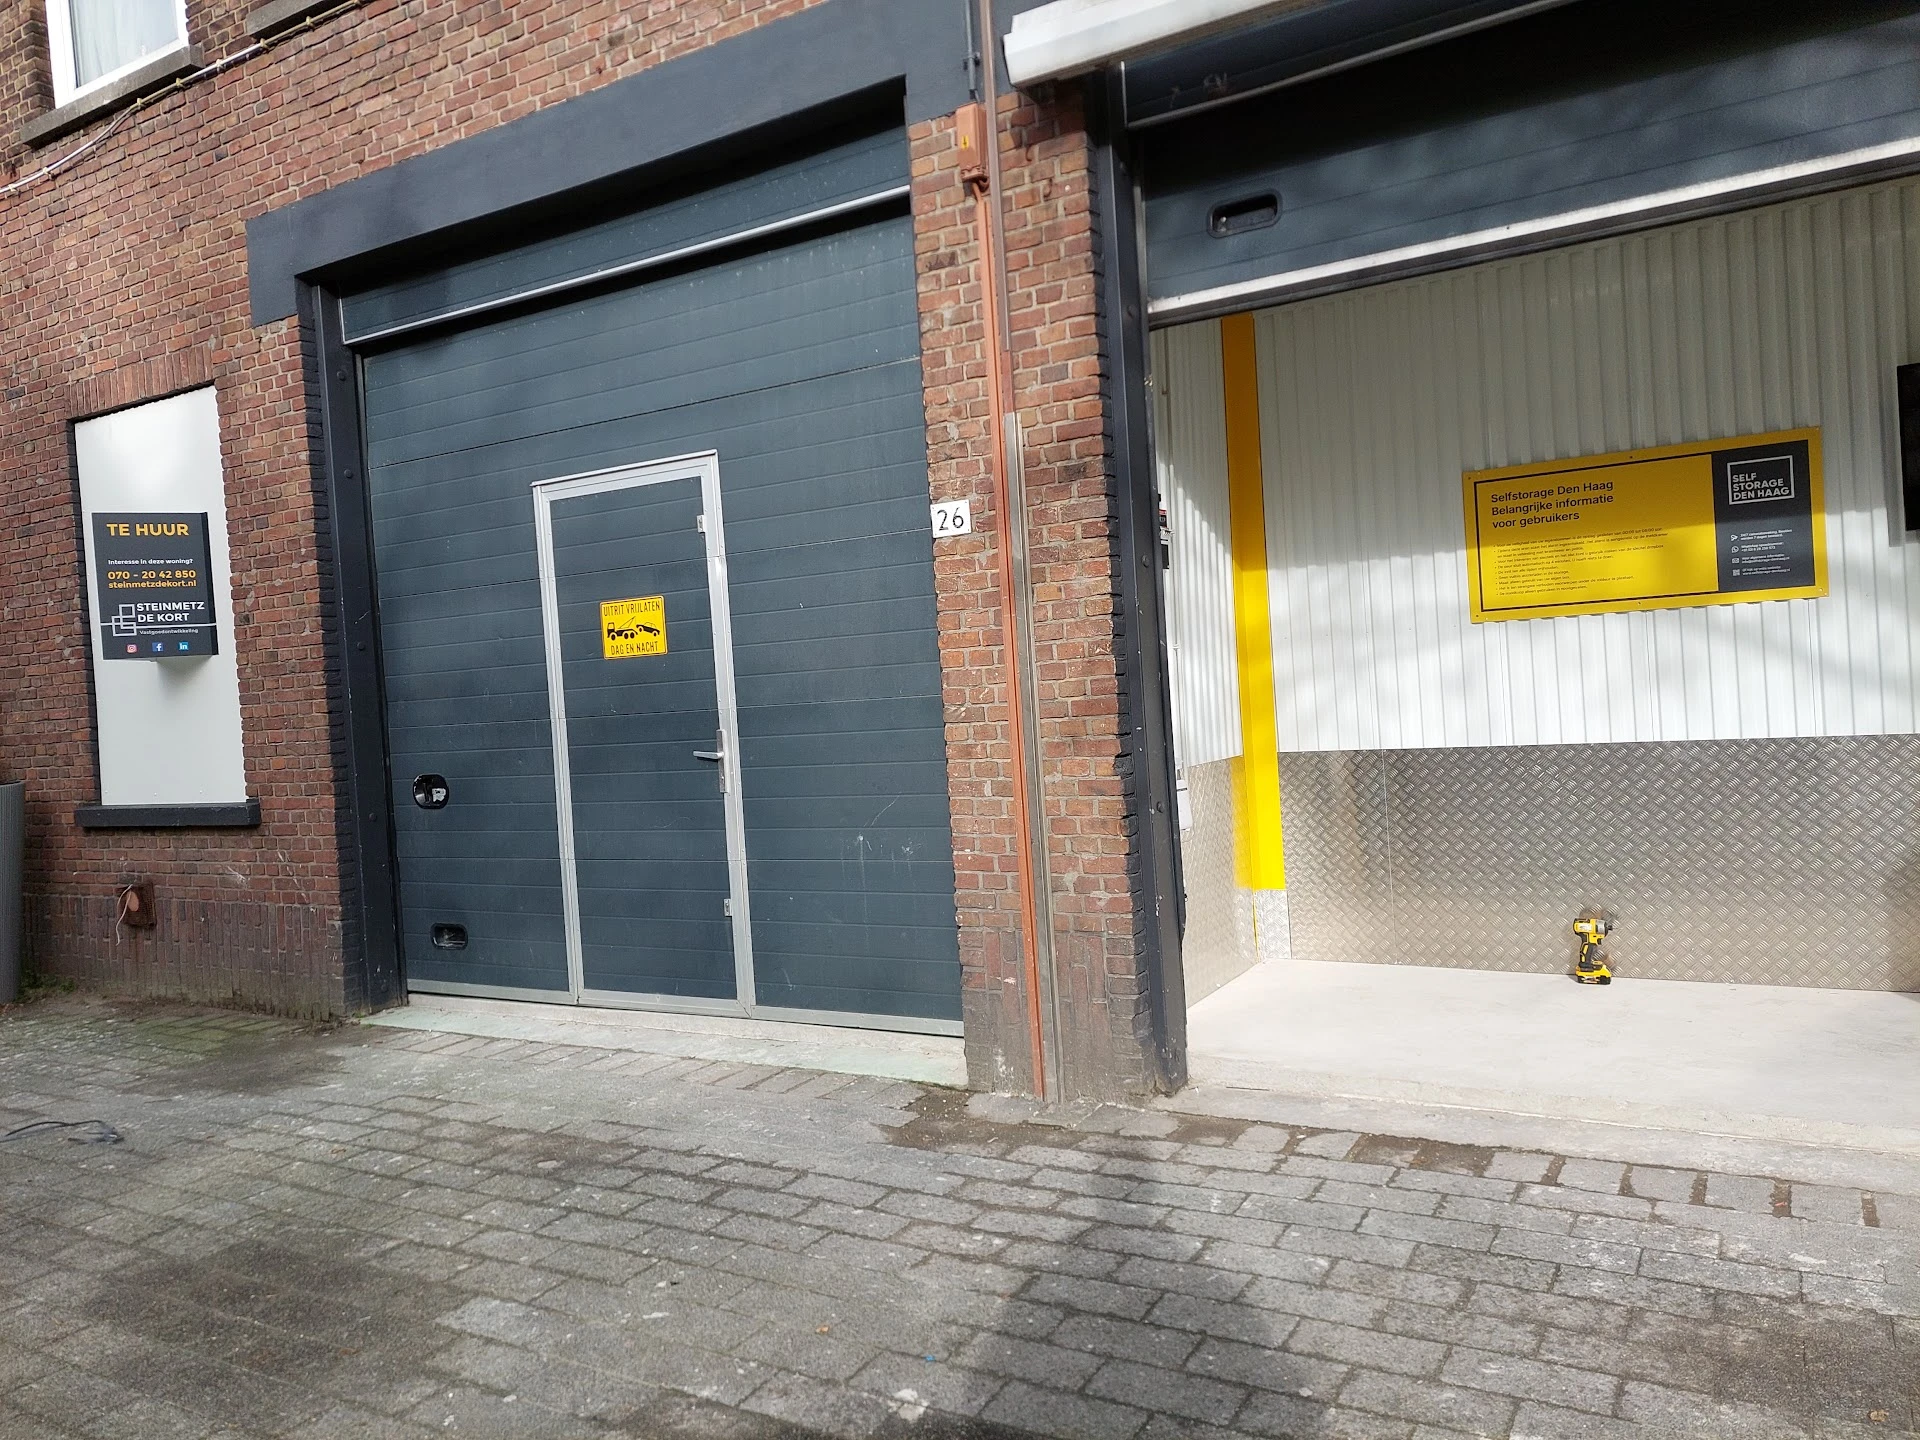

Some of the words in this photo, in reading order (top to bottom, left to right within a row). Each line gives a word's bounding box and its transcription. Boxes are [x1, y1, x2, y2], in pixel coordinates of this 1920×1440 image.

[1732, 472, 1757, 483] SELF
[1491, 488, 1554, 503] Selfstorage
[1557, 485, 1580, 495] Den
[1583, 481, 1614, 492] Haag
[1733, 478, 1784, 492] STORAGE
[1733, 491, 1755, 500] DEN
[1757, 487, 1790, 497] HAAG
[1492, 501, 1553, 516] Belangrijke
[1555, 494, 1614, 509] informatie
[937, 507, 964, 531] 26
[1492, 519, 1517, 529] voor
[1519, 512, 1580, 528] gebruikers
[106, 523, 131, 537] TE
[135, 523, 190, 536] HUUR
[165, 558, 194, 566] woning?
[107, 571, 131, 580] 070
[141, 570, 156, 579] 20
[158, 570, 173, 579] 42
[175, 570, 197, 579] 850
[108, 579, 197, 589] steinmetzdekort.nl
[136, 601, 205, 612] STEINMETZ
[603, 605, 624, 616] UITRIT
[626, 601, 660, 613] VRIJLATEN
[137, 613, 155, 623] DE
[157, 612, 190, 622] KORT
[611, 645, 624, 655] DAG
[626, 643, 634, 654] EN
[636, 641, 658, 653] NACHT
